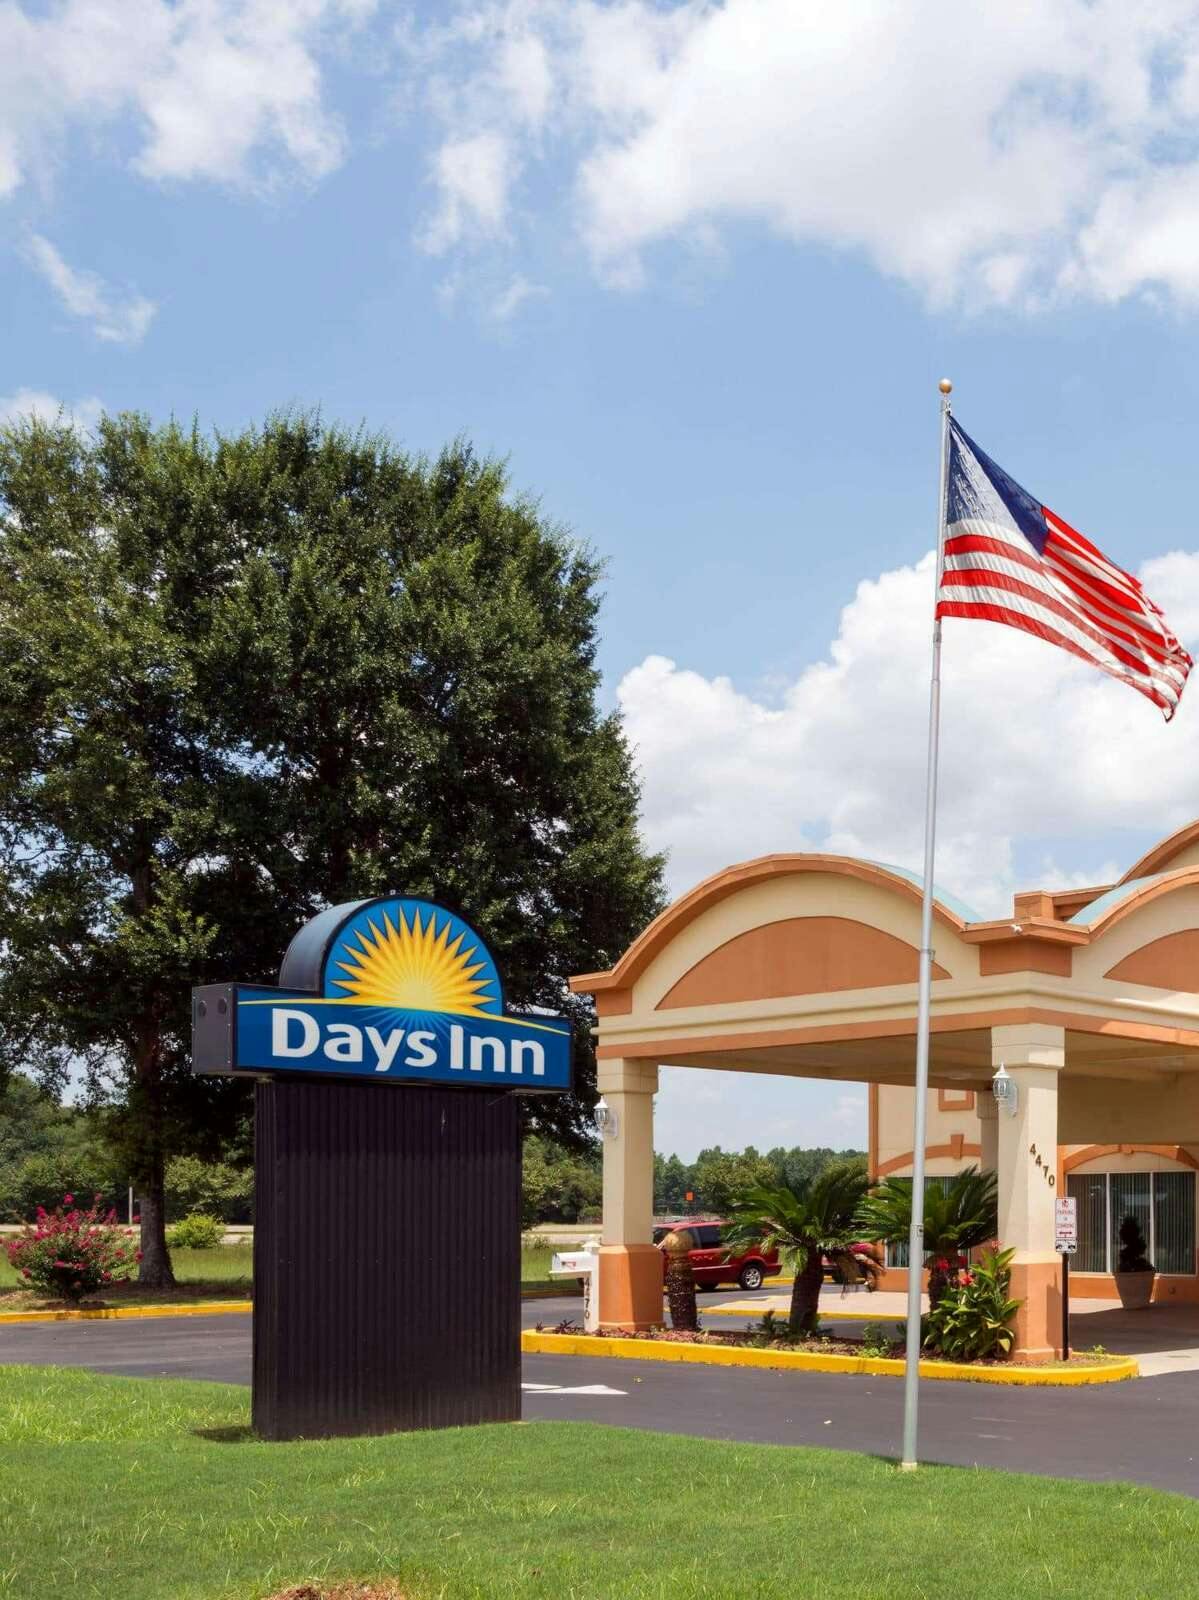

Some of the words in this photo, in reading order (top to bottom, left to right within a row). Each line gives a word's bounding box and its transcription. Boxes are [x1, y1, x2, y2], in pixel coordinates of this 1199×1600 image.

[272, 1008, 437, 1071] Days
[449, 1025, 545, 1076] Inn
[1029, 1144, 1054, 1186] 4470
